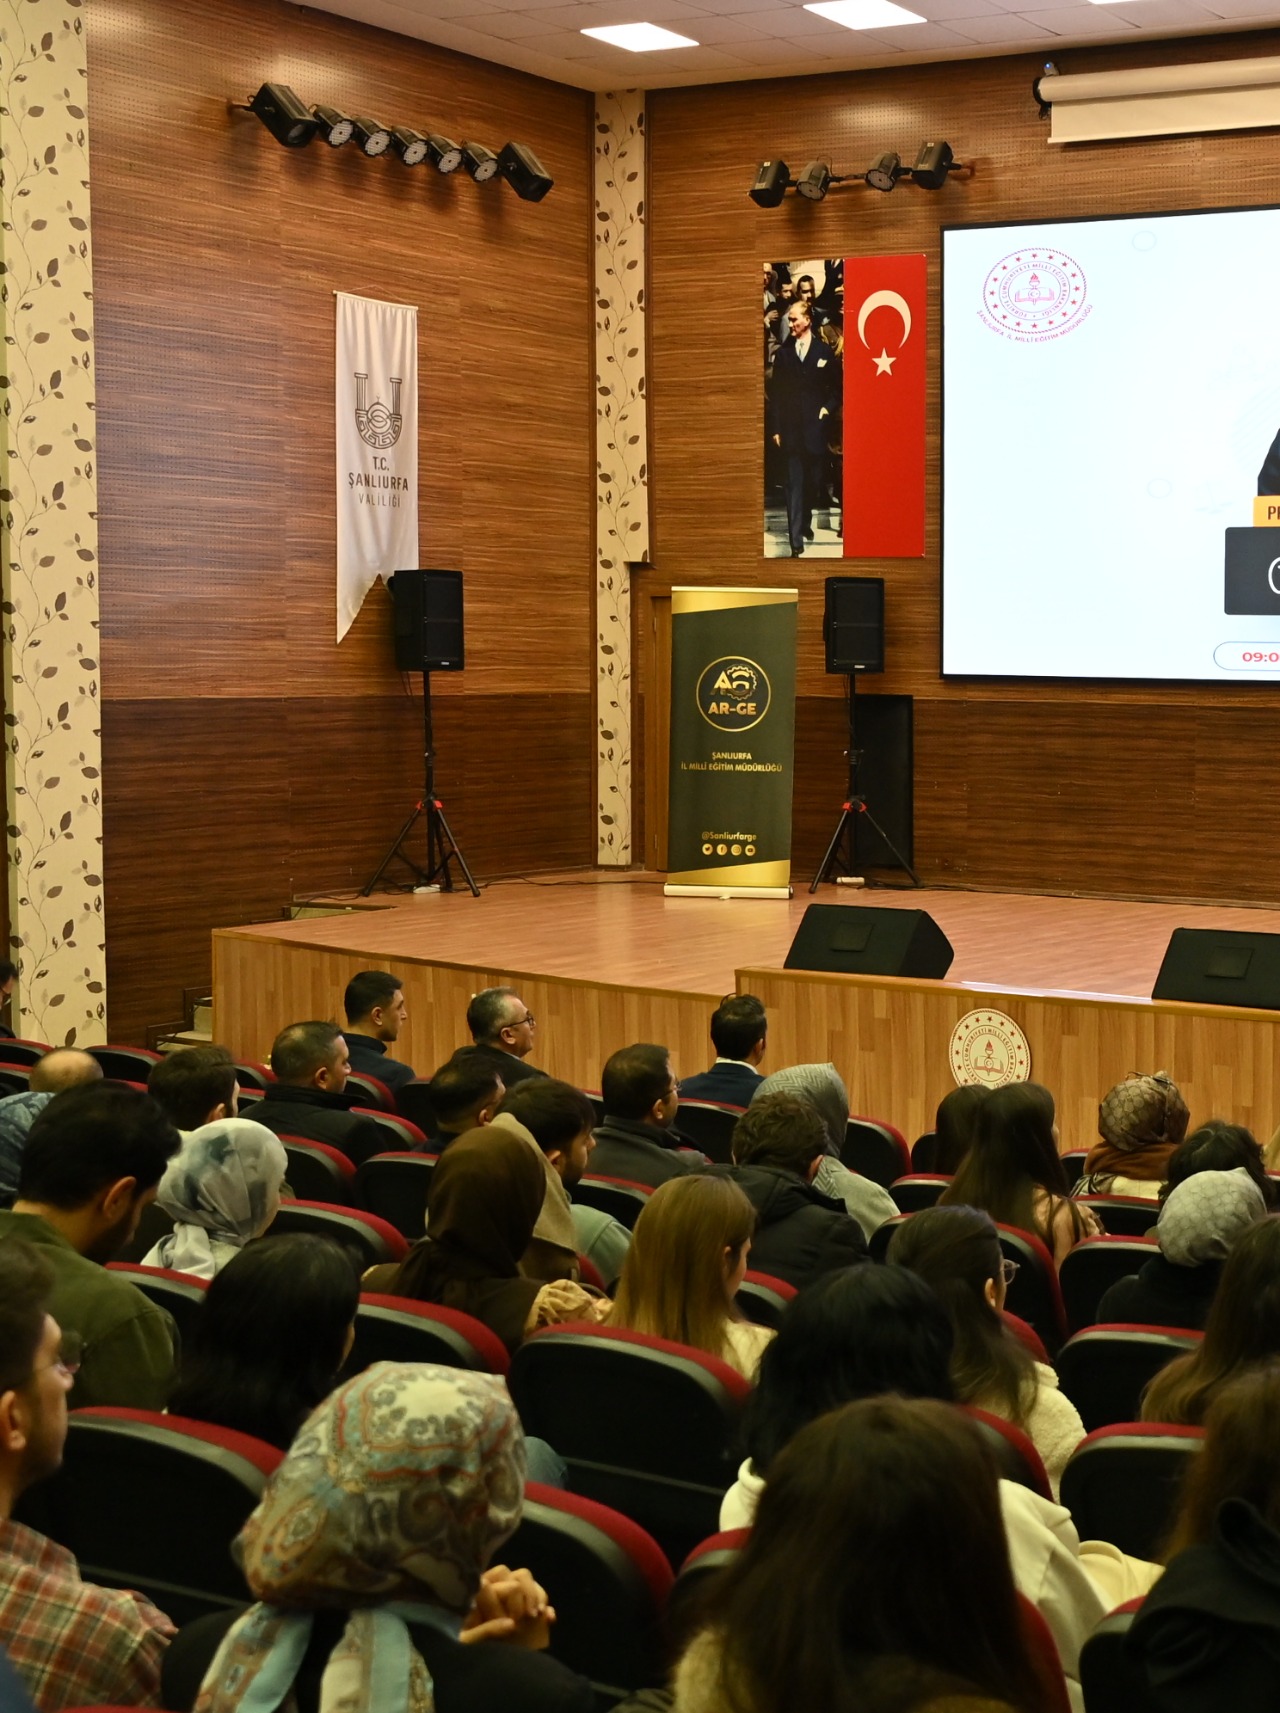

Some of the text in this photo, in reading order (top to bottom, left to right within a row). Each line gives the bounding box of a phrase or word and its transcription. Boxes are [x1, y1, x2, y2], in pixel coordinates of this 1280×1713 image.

[373, 456, 390, 471] T.C.
[348, 471, 409, 491] ŞANLIURFA
[358, 492, 401, 508] VALİLİĞİ
[708, 702, 757, 716] AR-GE
[712, 752, 752, 761] ŞANLIURFA
[681, 761, 688, 770] İL
[709, 761, 734, 771] EĞİTİM
[735, 762, 782, 773] MÜDÜRLÜĞÜ
